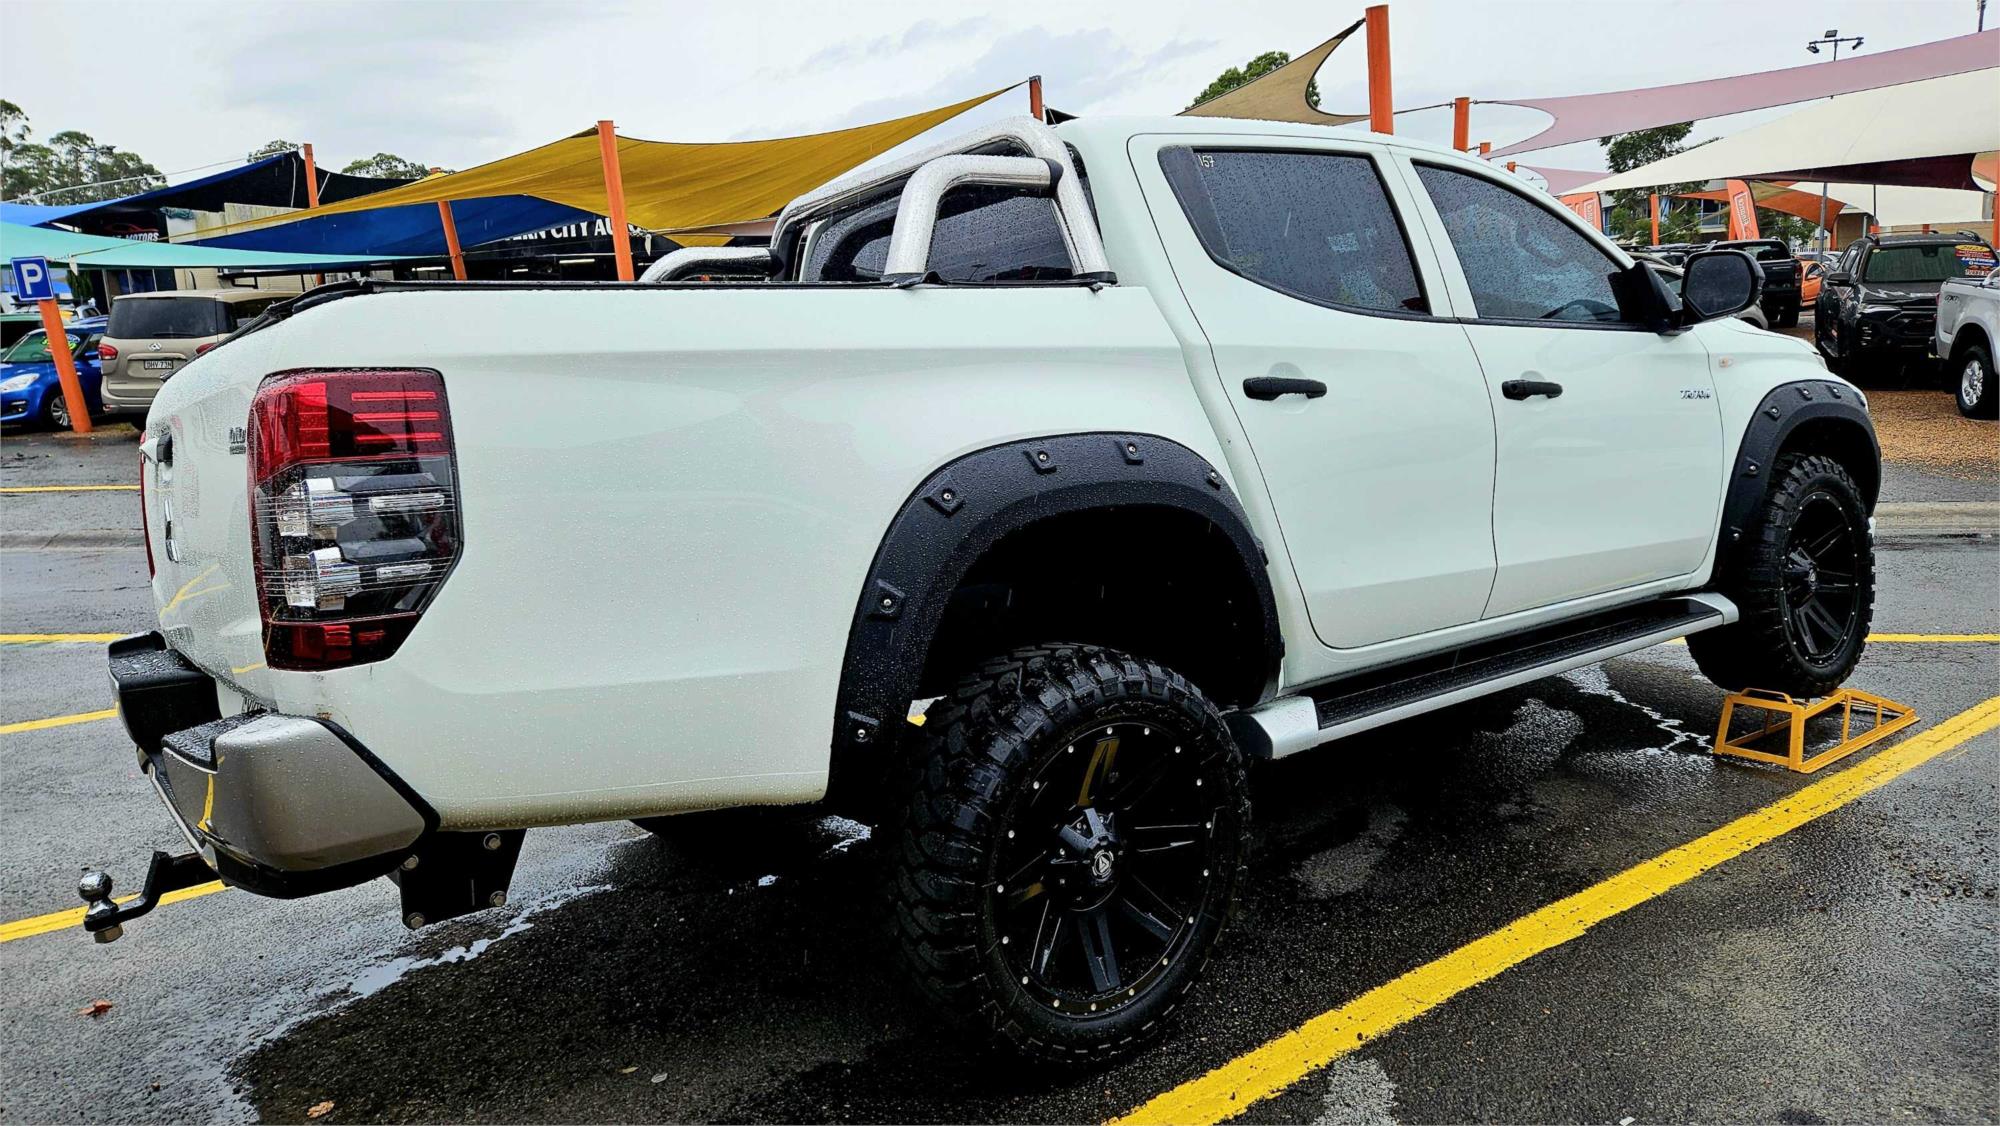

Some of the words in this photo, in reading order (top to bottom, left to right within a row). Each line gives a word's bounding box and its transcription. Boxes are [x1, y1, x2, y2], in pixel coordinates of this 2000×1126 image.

[1197, 154, 1215, 168] 157
[126, 232, 160, 242] MOTORS
[550, 220, 588, 239] CITY
[20, 263, 43, 295] P
